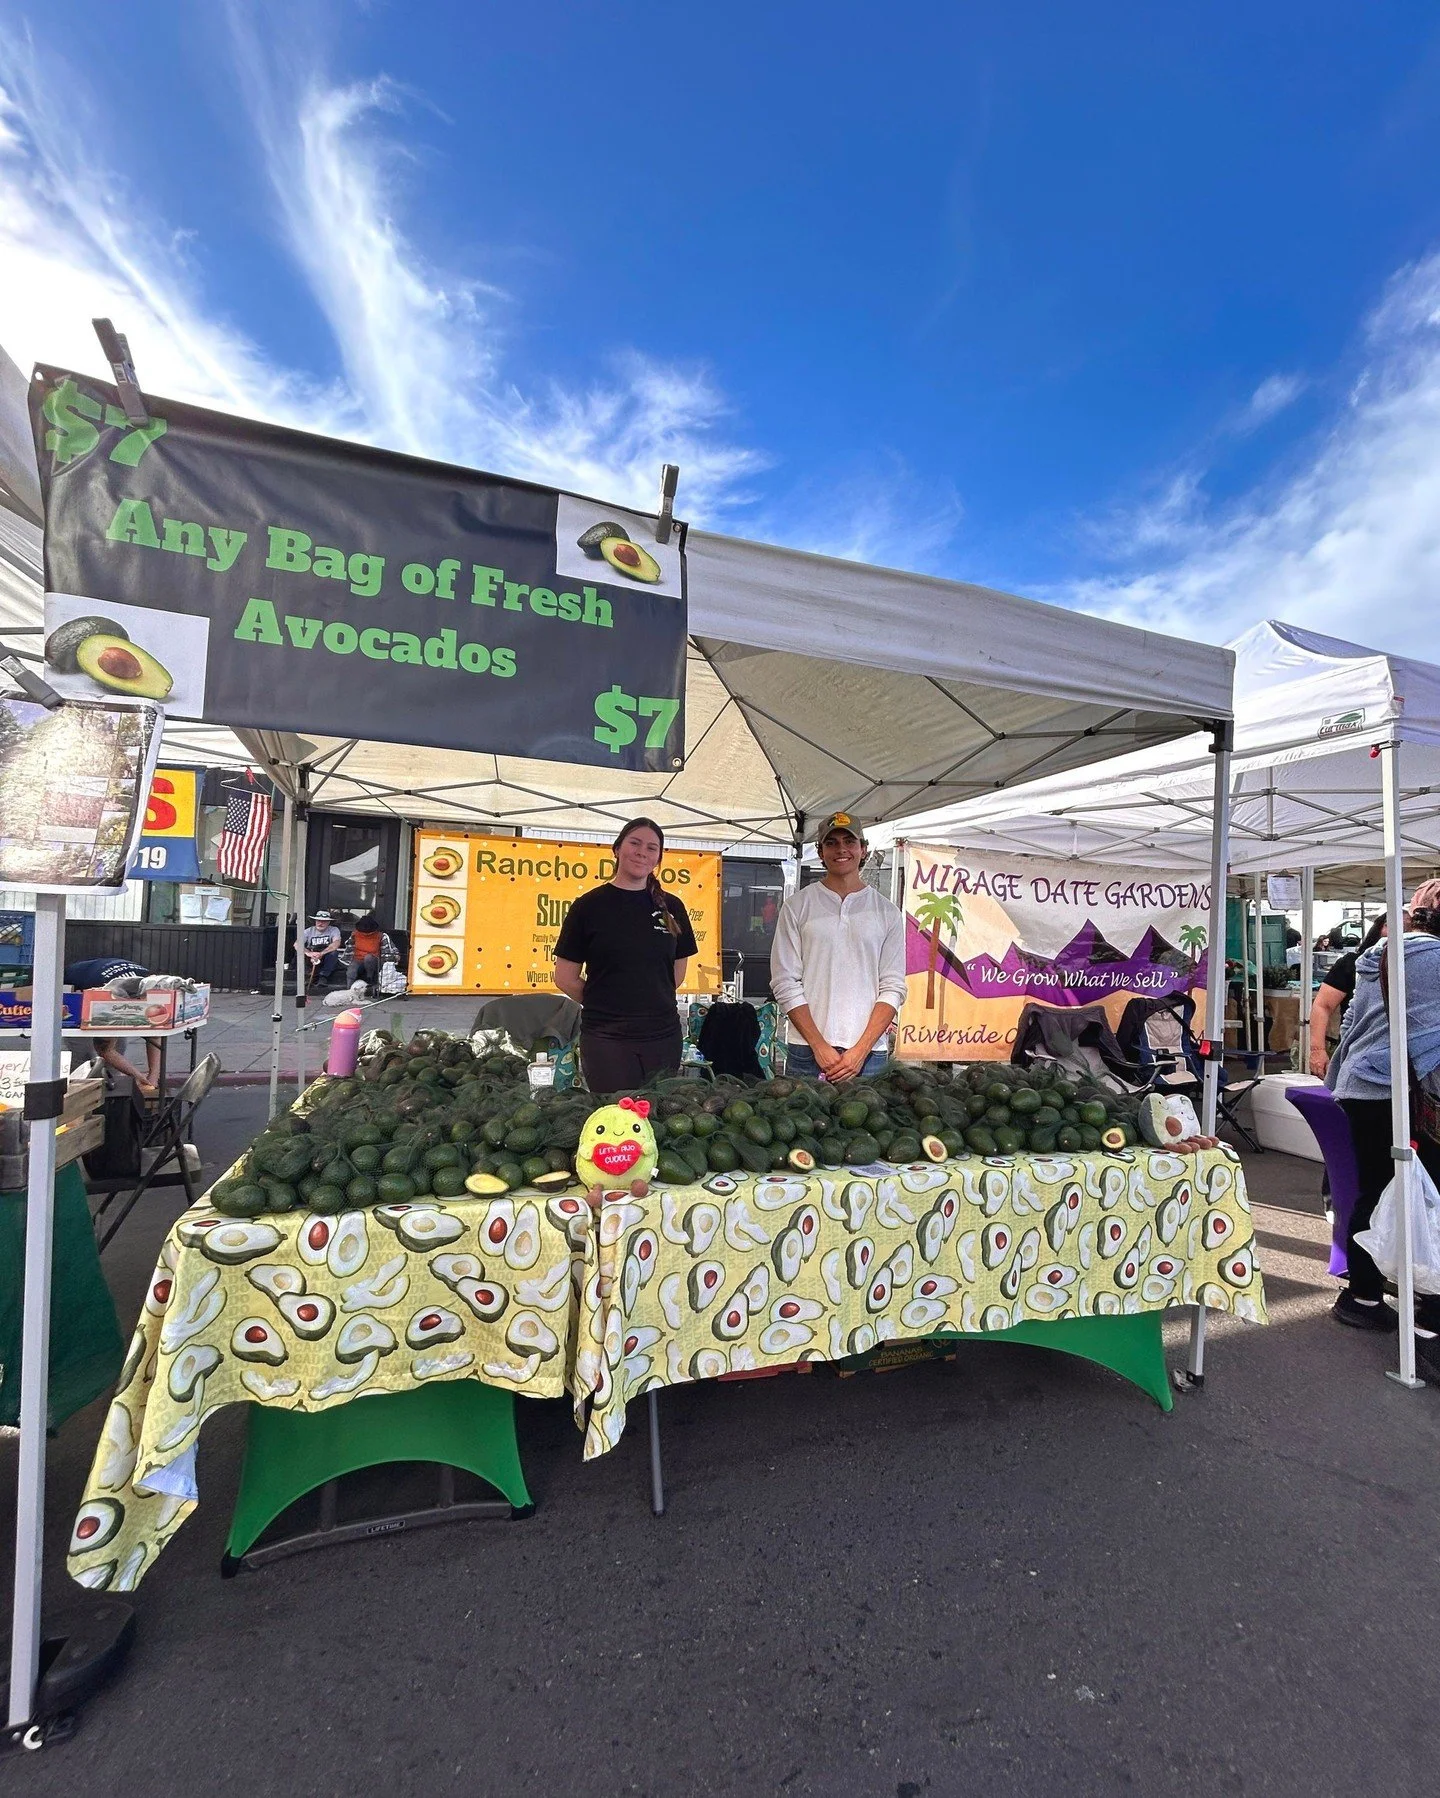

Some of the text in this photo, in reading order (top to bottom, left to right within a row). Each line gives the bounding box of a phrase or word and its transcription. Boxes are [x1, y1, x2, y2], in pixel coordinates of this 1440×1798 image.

[42, 379, 168, 468] $7
[105, 498, 614, 629] Any Bag of Fresh
[233, 597, 517, 678] Avocados
[594, 684, 680, 754] $7
[134, 845, 167, 870] 19
[476, 850, 588, 879] Rancho
[912, 860, 1212, 911] MIRAGE DATE GARDENS
[526, 970, 549, 983] Where
[1012, 968, 1060, 987] Grow
[1063, 969, 1111, 988] What
[1110, 971, 1132, 987] We
[901, 1023, 1003, 1045] Riverside
[604, 1154, 632, 1165] CUDDLE
